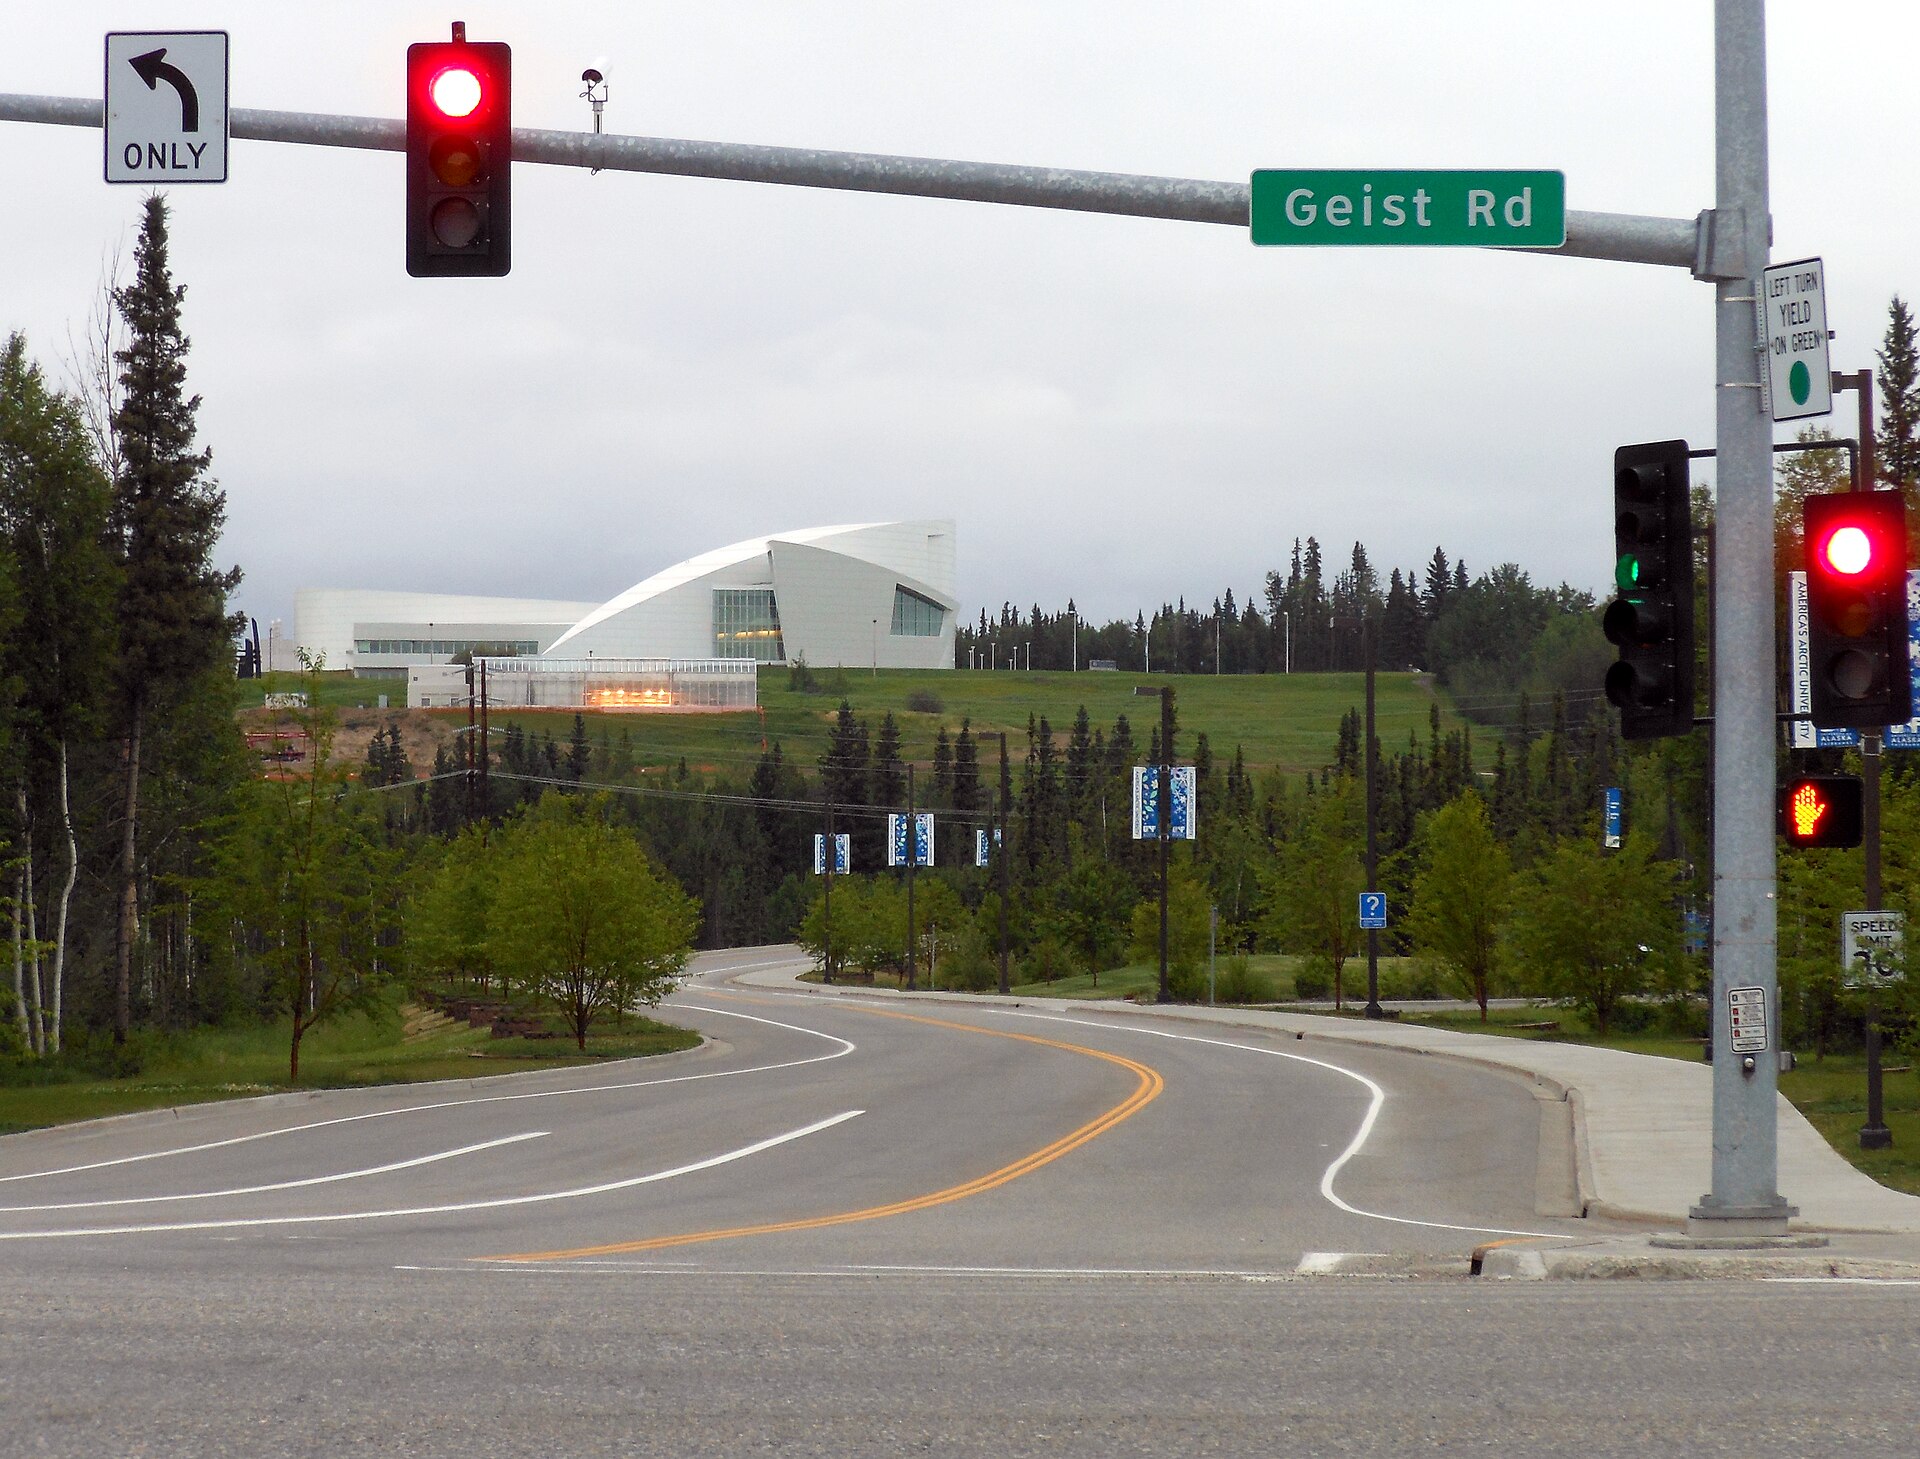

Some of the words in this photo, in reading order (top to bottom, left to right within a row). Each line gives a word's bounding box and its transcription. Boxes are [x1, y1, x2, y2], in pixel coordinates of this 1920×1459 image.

[124, 142, 208, 170] ONLY
[1285, 183, 1432, 227] Geist
[1468, 187, 1532, 227] Rd
[1769, 276, 1790, 298] LEFT
[1795, 271, 1818, 293] TURN
[1780, 300, 1811, 327] YIELD
[1775, 335, 1787, 355] ON
[1792, 329, 1821, 352] GREEN
[1797, 581, 1808, 636] AMERICA'S
[1798, 639, 1809, 676] ARCTIC
